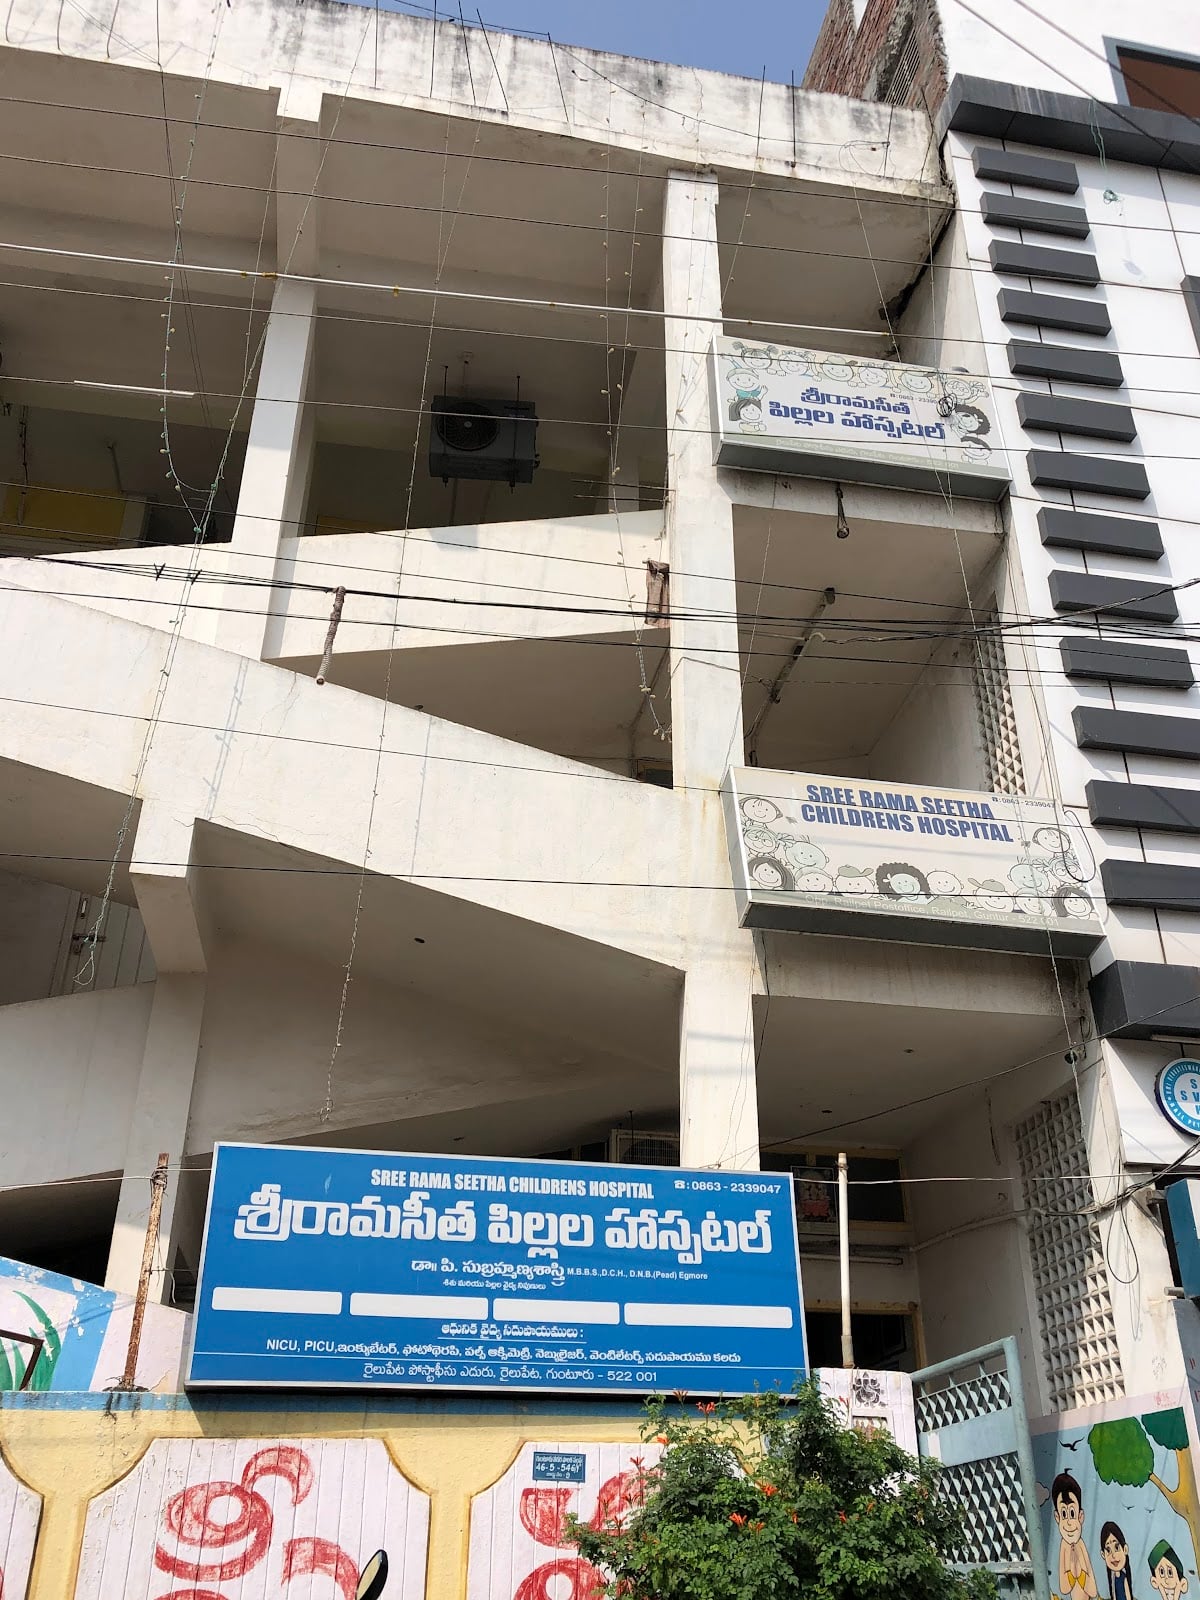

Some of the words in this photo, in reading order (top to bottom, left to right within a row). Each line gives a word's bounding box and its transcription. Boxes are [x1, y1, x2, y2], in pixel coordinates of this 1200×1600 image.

[769, 401, 835, 427] పిల్లల
[806, 784, 857, 808] SREE
[858, 790, 918, 812] RAMA
[919, 796, 995, 819] SEETHA
[801, 804, 914, 833] CHILDRENS
[918, 815, 1014, 842] HOSPITAL
[370, 1168, 407, 1187] SREE
[409, 1171, 452, 1189] RAMA
[454, 1173, 507, 1192] SEETHA
[508, 1176, 587, 1197] CHILDRENS
[589, 1180, 655, 1199] HOSPITAL
[730, 1182, 781, 1194] 2339047
[233, 1183, 477, 1242] శ్రీరామసీత
[487, 1203, 594, 1260] పిల్లల
[678, 1271, 708, 1281] Egmore
[266, 1339, 301, 1353] NICU,
[713, 1352, 741, 1363] కలదు
[607, 1370, 633, 1382] 522
[636, 1371, 657, 1382] 001
